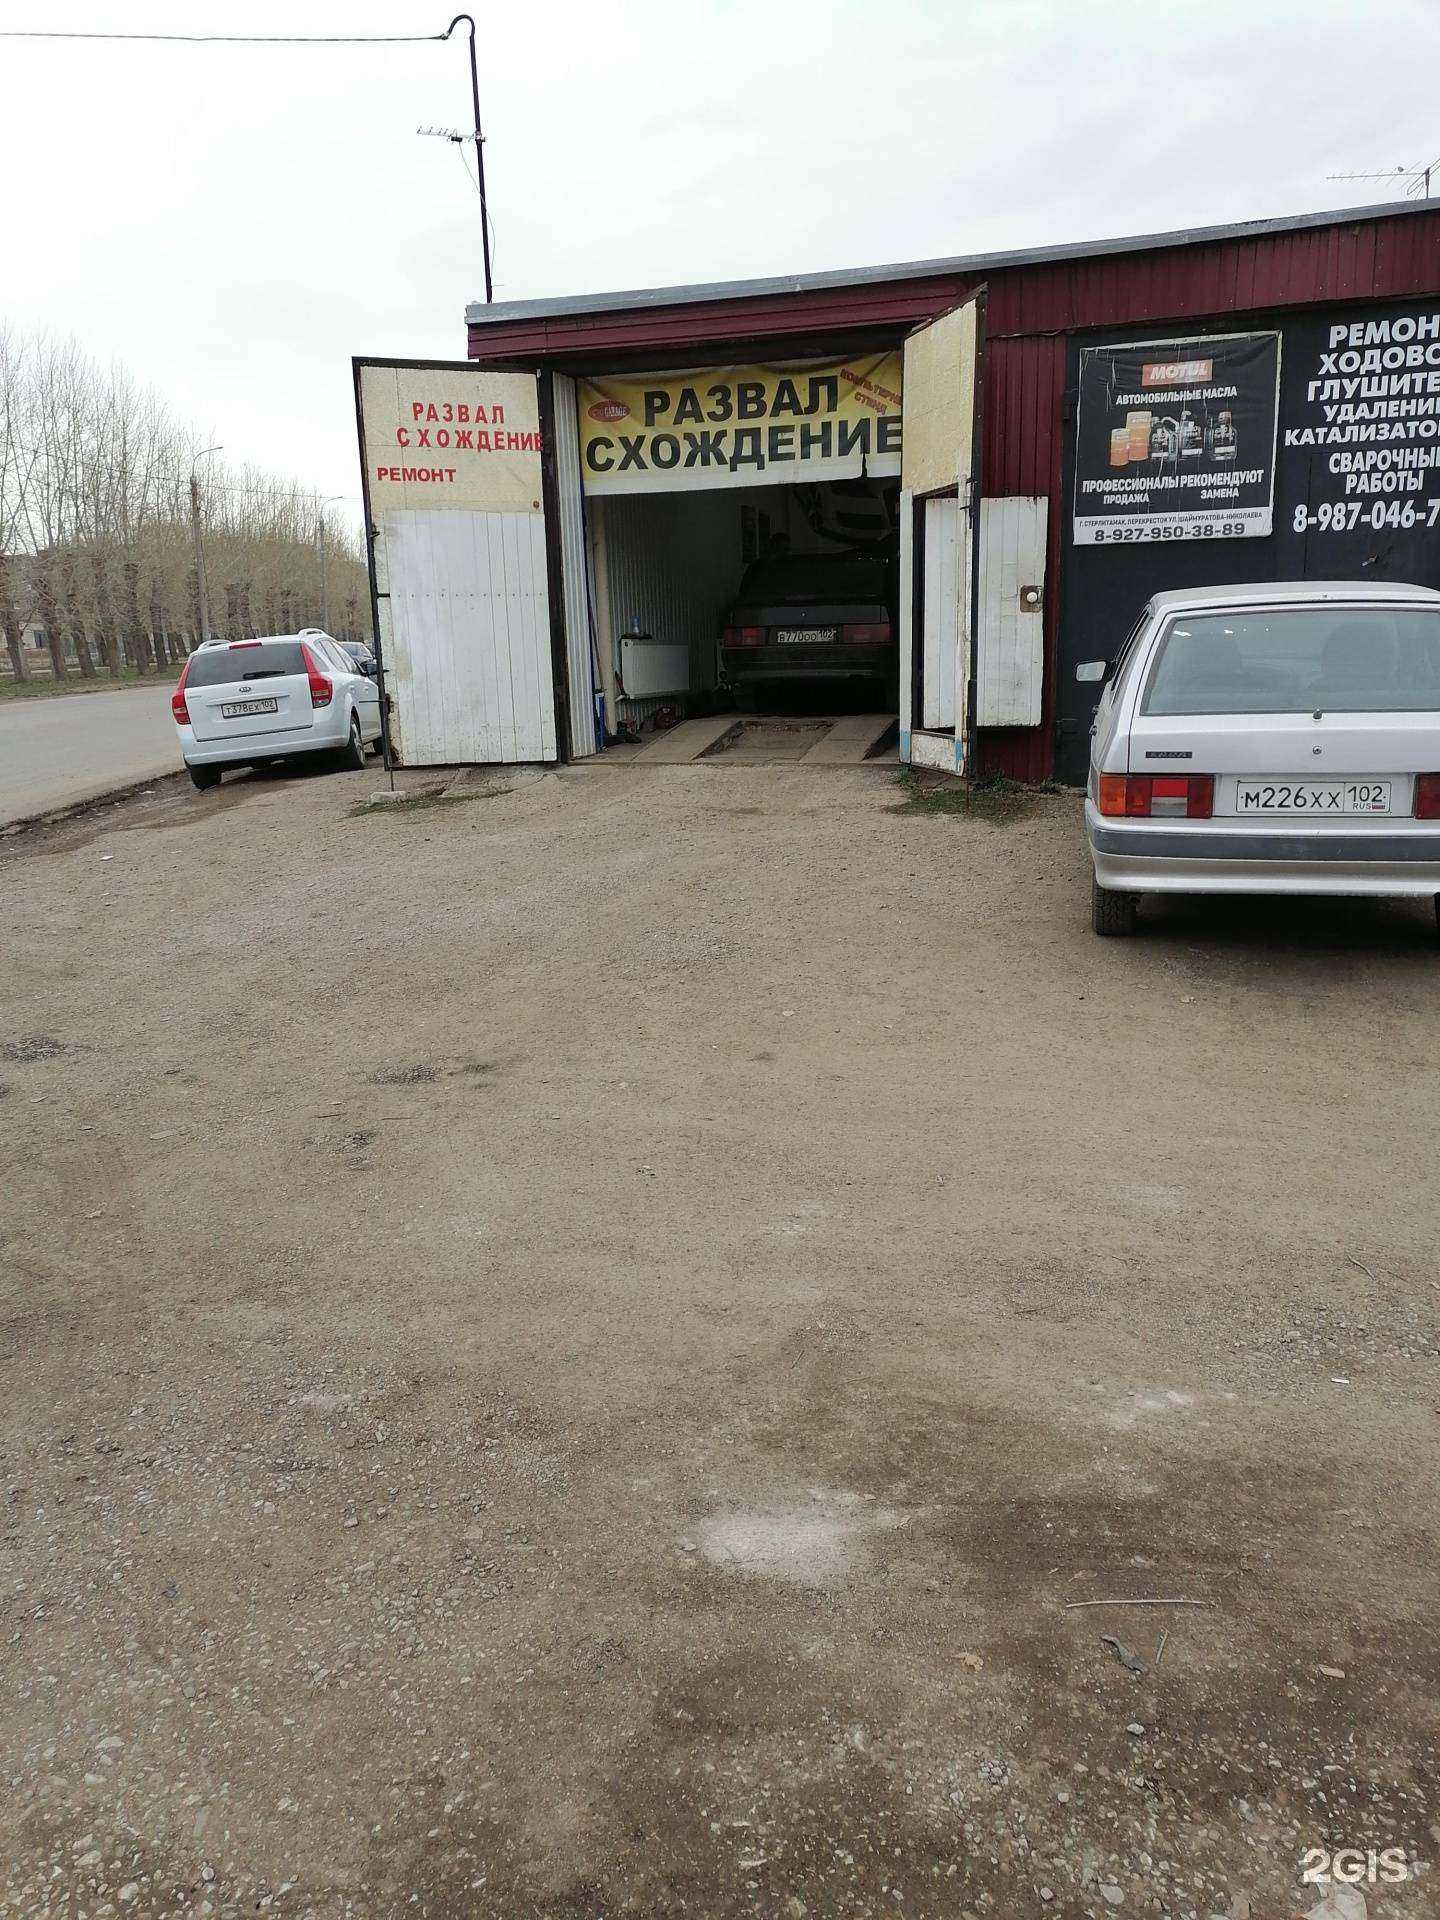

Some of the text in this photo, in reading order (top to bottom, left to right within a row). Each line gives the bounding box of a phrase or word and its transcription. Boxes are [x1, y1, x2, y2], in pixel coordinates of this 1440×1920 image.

[1329, 314, 1440, 348] РЕМОН
[1150, 362, 1208, 380] MOTUL
[1116, 386, 1238, 405] АВТОМОБИЛЬНЫЕ МАСЛА
[1308, 371, 1440, 401] ГЛУШИТЕ
[412, 402, 505, 424] РАЗВАЛ
[643, 375, 838, 427] РАЗВАЛ
[396, 427, 543, 452] СХОЖДЕНИЕ
[586, 415, 903, 473] СХОЖДЕНИЕ
[1285, 419, 1440, 446] КАТАЛИЗАТО
[377, 467, 457, 482] РЕМОНТ
[1082, 469, 1264, 493] ПРОФЕССИОНАЛЫ РЕКОМЕНДУЮТ
[1345, 470, 1424, 495] РАБОТЫ
[1103, 487, 1240, 505] ПРОДАЖА ЗАМЕНА
[1293, 499, 1440, 533] 8-987-046-7
[1094, 523, 1245, 541] 8-927-950-38-89
[1348, 785, 1383, 802] 102
